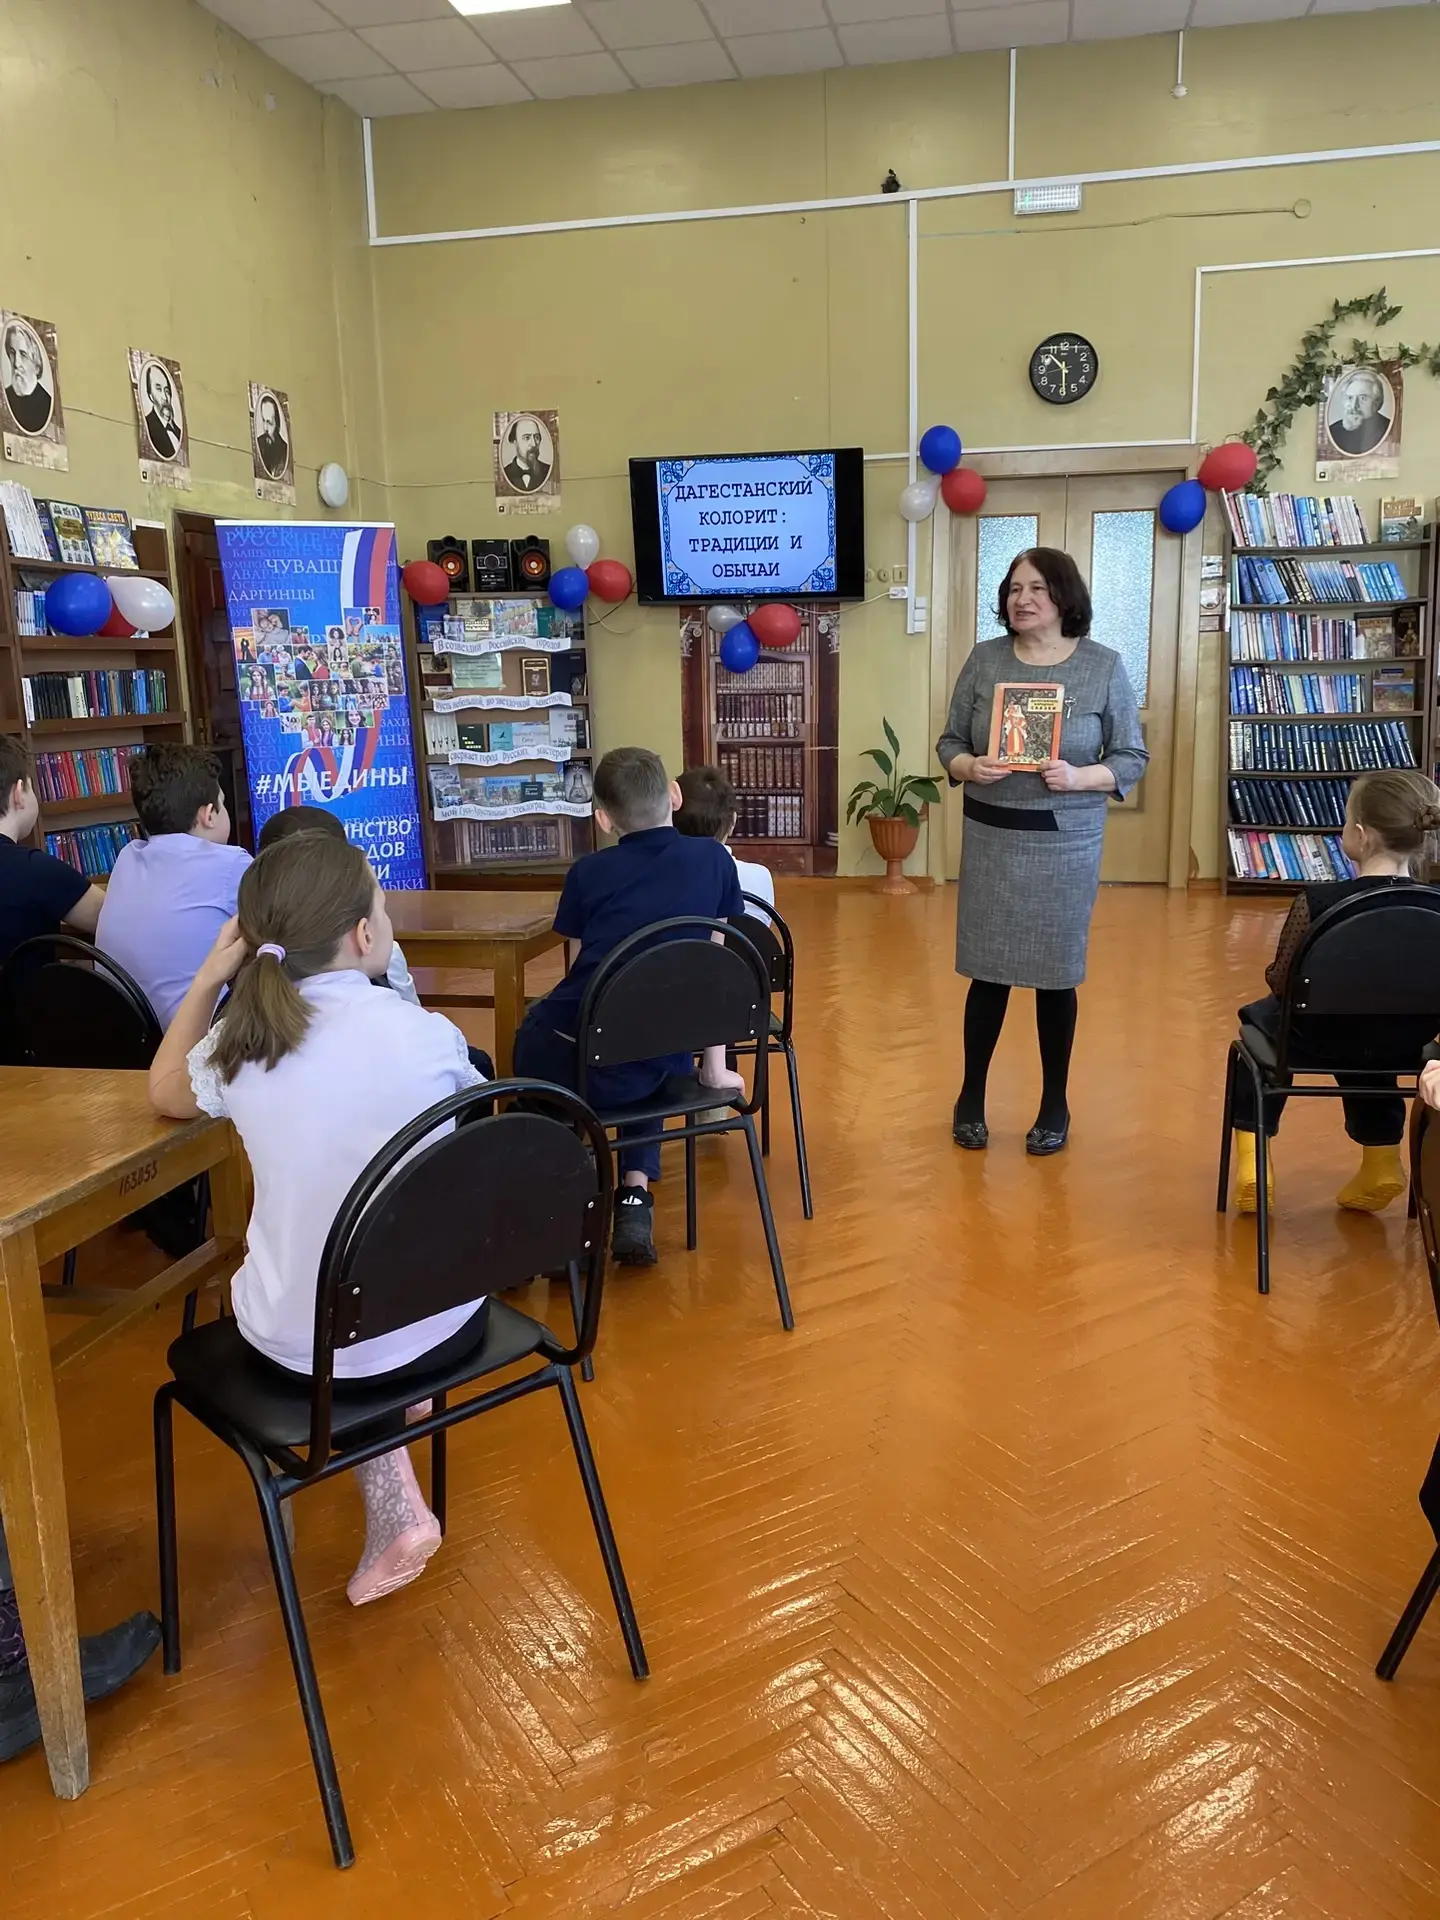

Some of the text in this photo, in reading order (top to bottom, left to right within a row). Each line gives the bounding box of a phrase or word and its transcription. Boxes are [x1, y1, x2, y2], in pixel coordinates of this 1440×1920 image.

[1060, 341, 1070, 351] 12
[1079, 352, 1088, 362] 2
[1038, 365, 1046, 375] 9
[1082, 363, 1090, 373] 3
[1040, 376, 1048, 386] 8
[1078, 375, 1086, 384] 4
[1049, 384, 1057, 393] 7
[1059, 386, 1067, 396] 6
[1070, 383, 1078, 393] 5
[675, 475, 813, 502] ДАГЕСТАНСКИЙ
[699, 509, 787, 525] КОЛОРИТ:
[225, 530, 321, 548] РУССКИЕ
[321, 527, 346, 540] ТАТ
[689, 535, 802, 553] ТРАДИЦИИ И
[265, 558, 343, 575] ЧУВАШ
[712, 562, 780, 577] ОБЫЧАИ
[228, 588, 317, 603] ДАРГИНЦЫ
[438, 639, 444, 651] В
[380, 717, 411, 728] ЗАХИ
[502, 748, 529, 763] русских
[537, 747, 568, 761] мастеров
[362, 841, 406, 861] ДОВ
